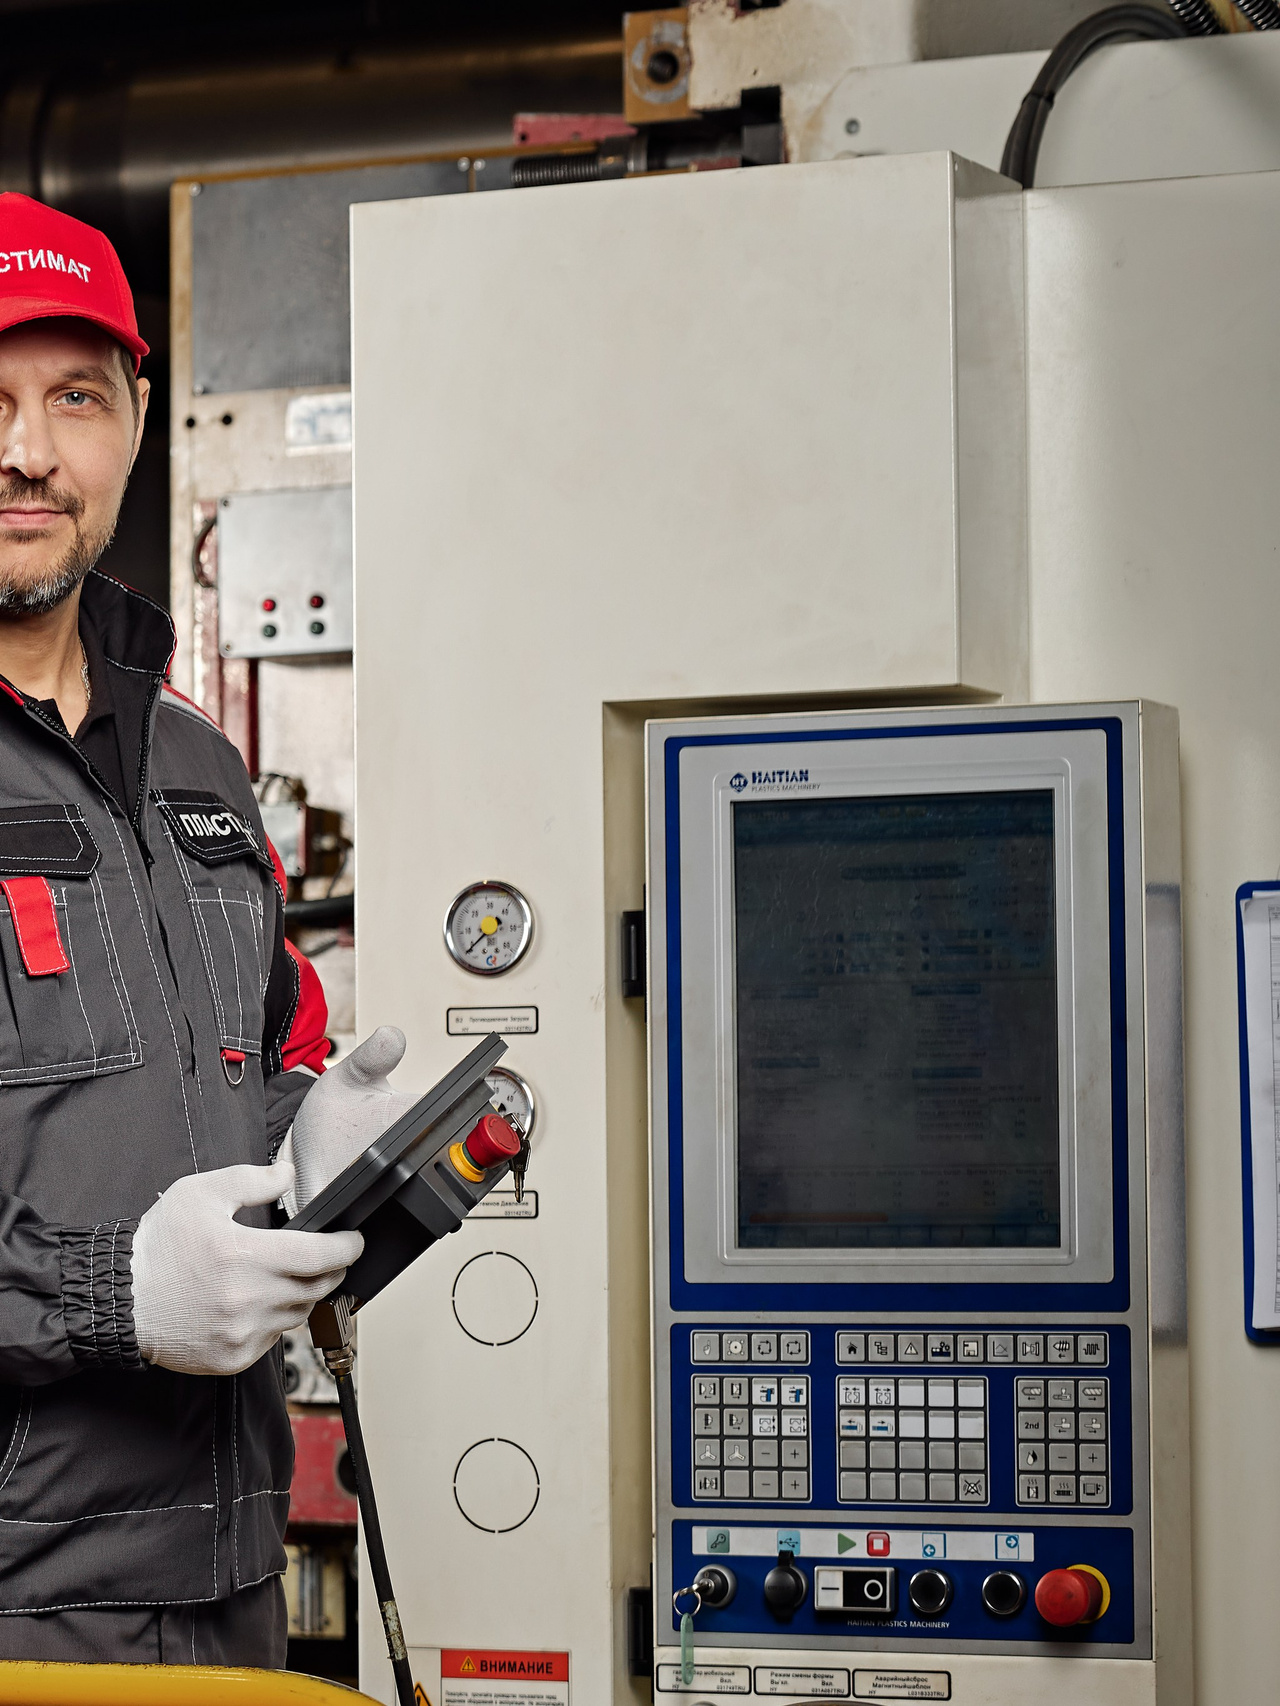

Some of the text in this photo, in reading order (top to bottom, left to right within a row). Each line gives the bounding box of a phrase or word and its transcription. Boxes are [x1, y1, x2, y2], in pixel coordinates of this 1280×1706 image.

[751, 769, 809, 784] HAITIAN
[1024, 1421, 1040, 1430] 2nd
[877, 1620, 908, 1628] PLASTICS
[909, 1620, 950, 1629] MACHINERY
[480, 1659, 553, 1674] ВНИМАНИЕ
